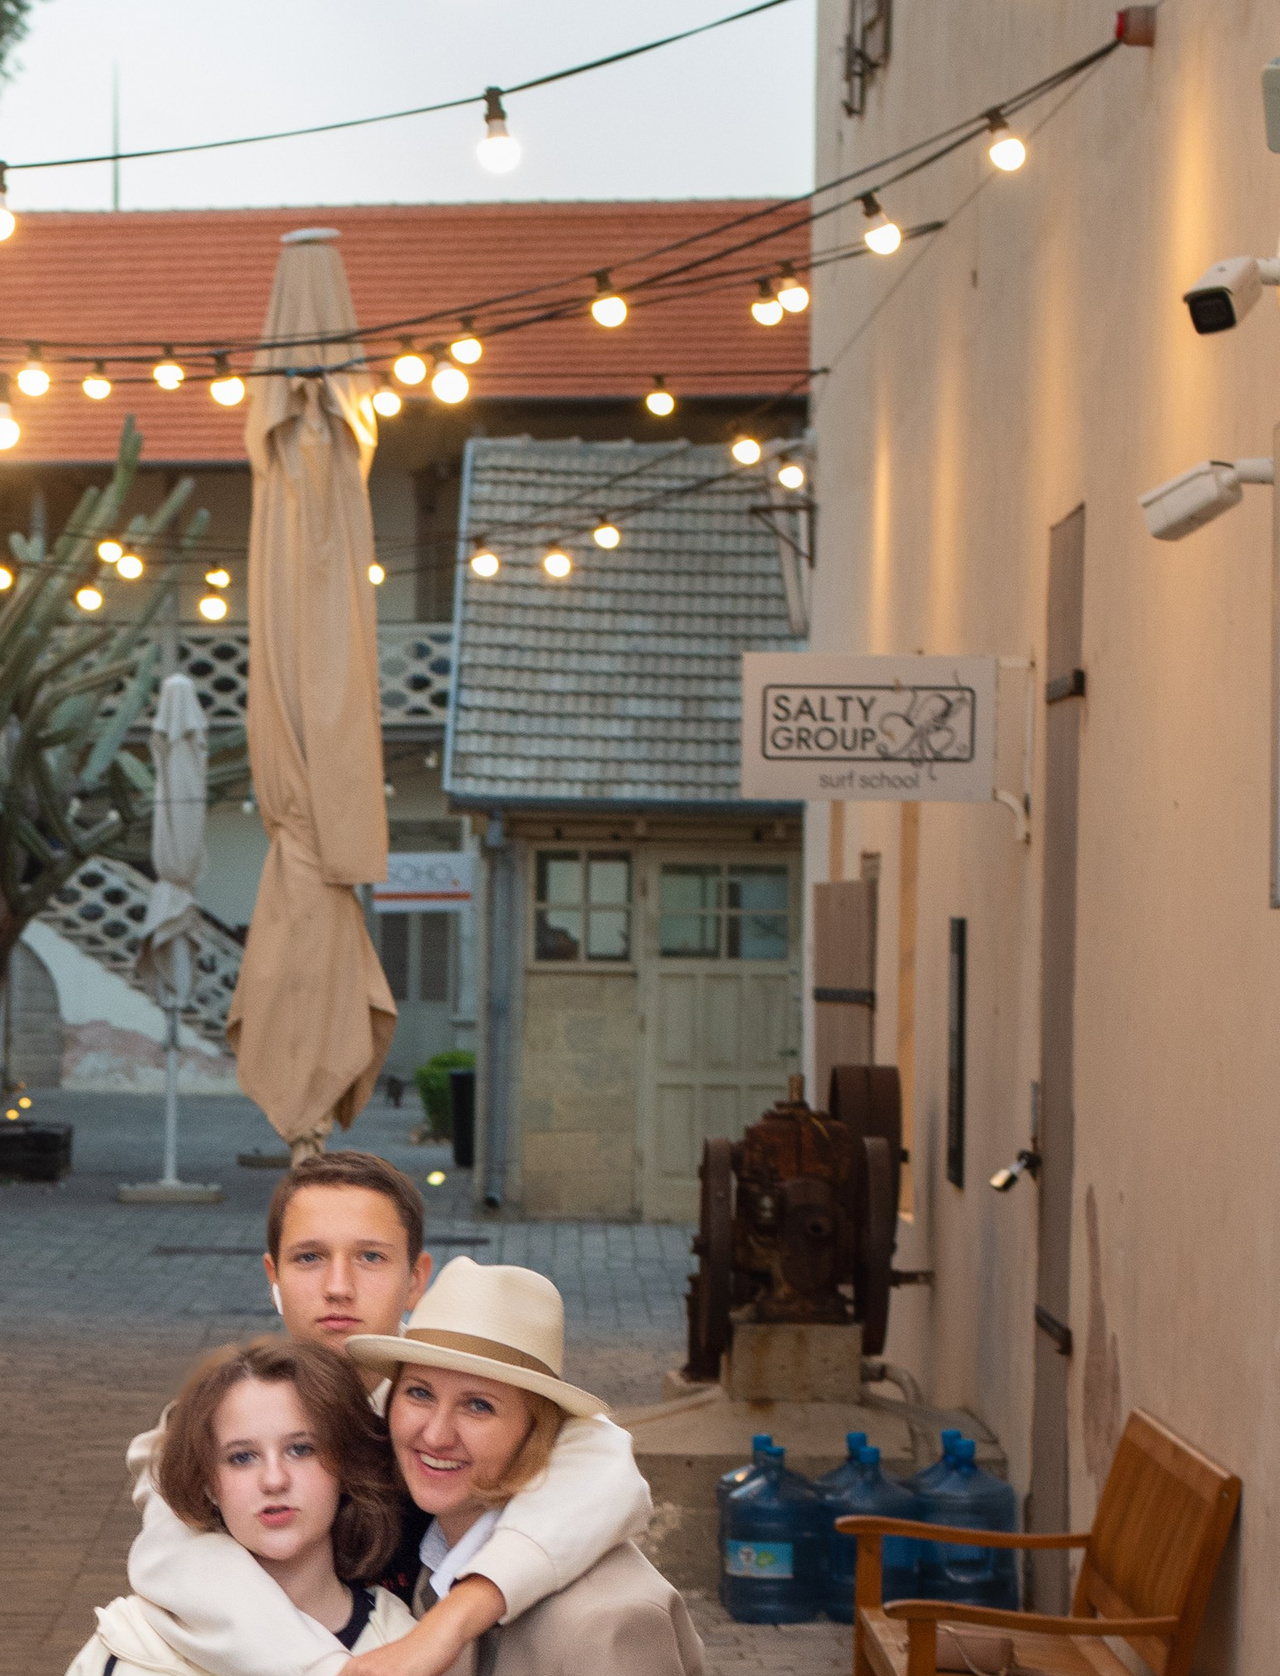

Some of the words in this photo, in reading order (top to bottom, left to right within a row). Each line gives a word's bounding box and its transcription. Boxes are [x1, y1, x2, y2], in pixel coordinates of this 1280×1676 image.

[772, 694, 877, 723] SALTY
[770, 726, 877, 752] GROUP
[819, 769, 855, 789] surf
[859, 770, 921, 790] school
